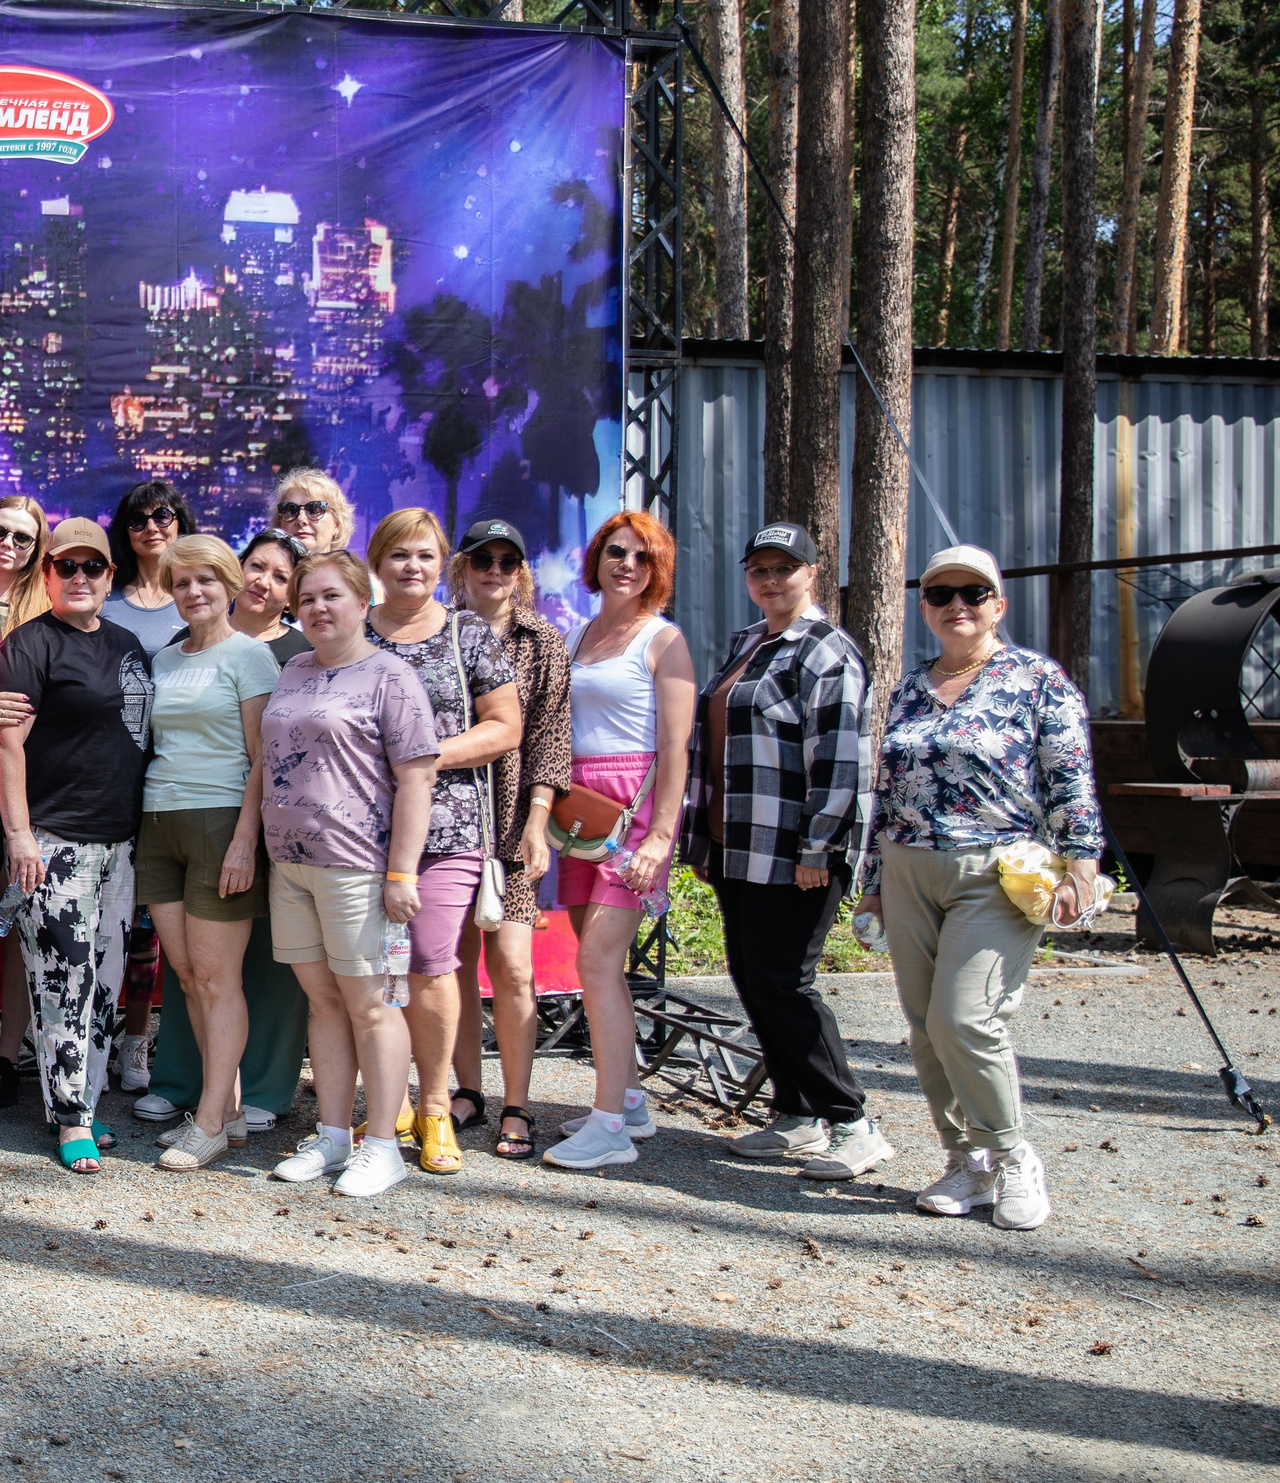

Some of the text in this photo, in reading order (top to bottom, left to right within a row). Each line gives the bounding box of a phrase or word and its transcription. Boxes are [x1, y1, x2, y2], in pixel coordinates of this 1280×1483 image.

[52, 101, 90, 110] СЕТЬ
[35, 142, 56, 152] 1997
[58, 145, 77, 156] года
